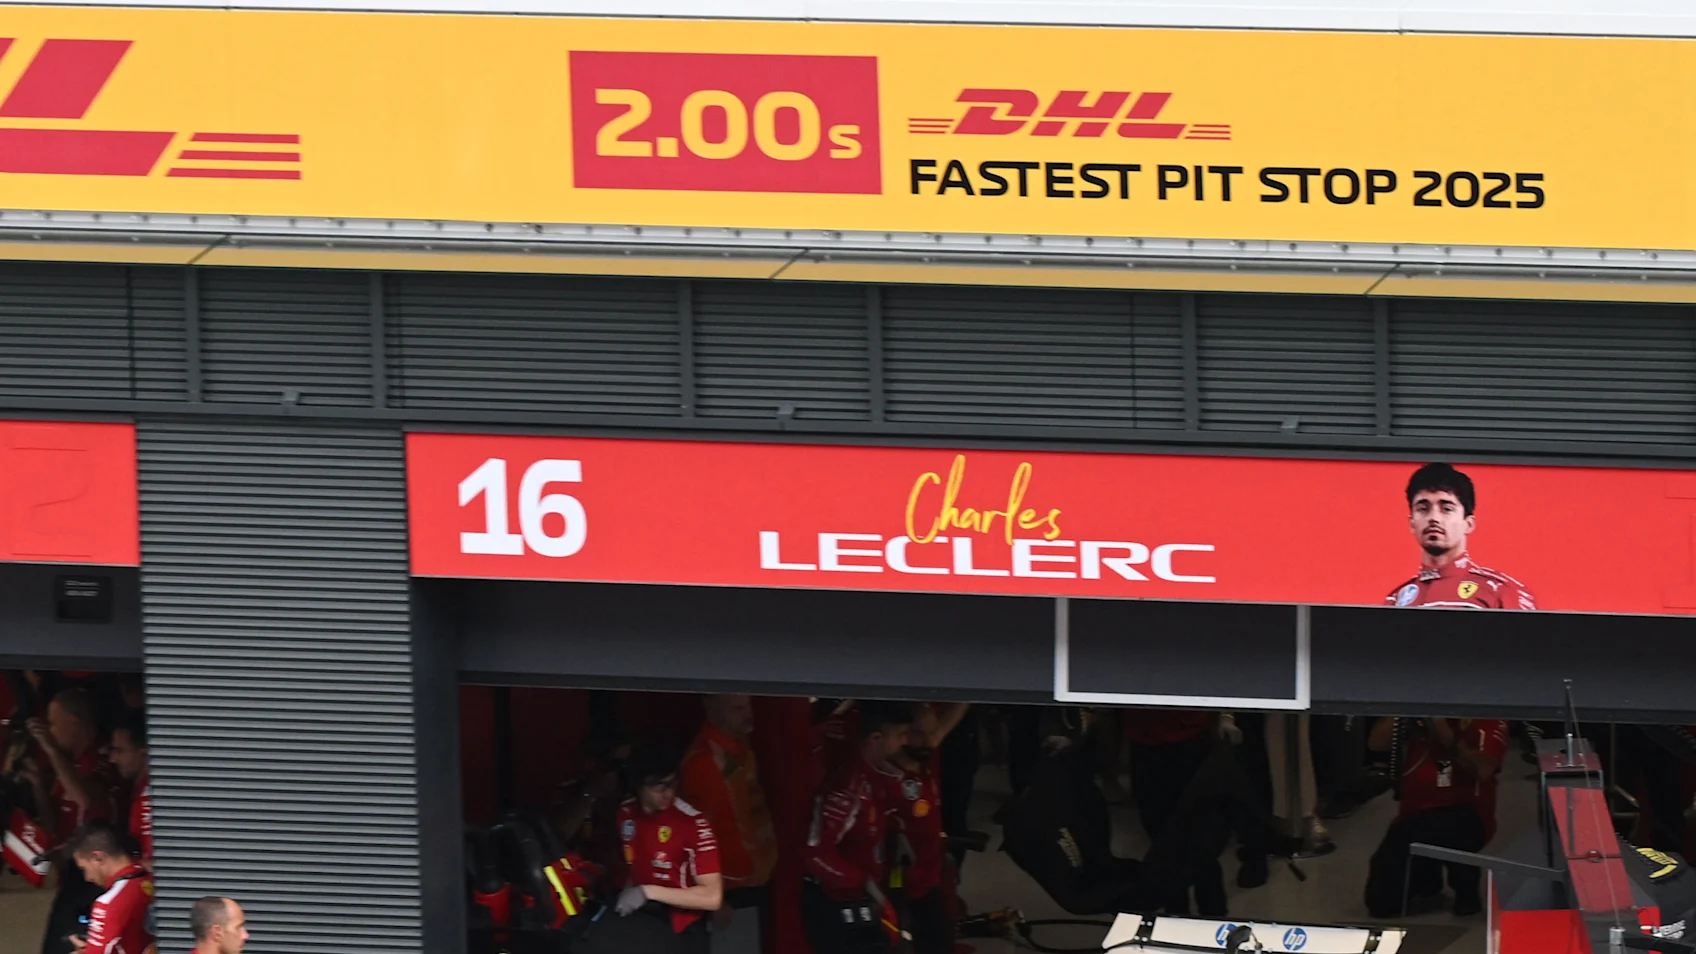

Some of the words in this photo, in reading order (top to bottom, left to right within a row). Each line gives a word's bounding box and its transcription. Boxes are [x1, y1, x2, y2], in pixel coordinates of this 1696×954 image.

[595, 88, 861, 161] 2.00s
[952, 88, 1186, 140] DHL
[909, 159, 1141, 200] FASTEST
[1157, 164, 1243, 202] PIT
[1259, 166, 1397, 206] STOP
[1414, 170, 1545, 210] 2025
[458, 458, 588, 558] 16
[906, 454, 1062, 545] Charles
[759, 531, 1215, 584] LECLERC
[1283, 927, 1307, 951] hp
